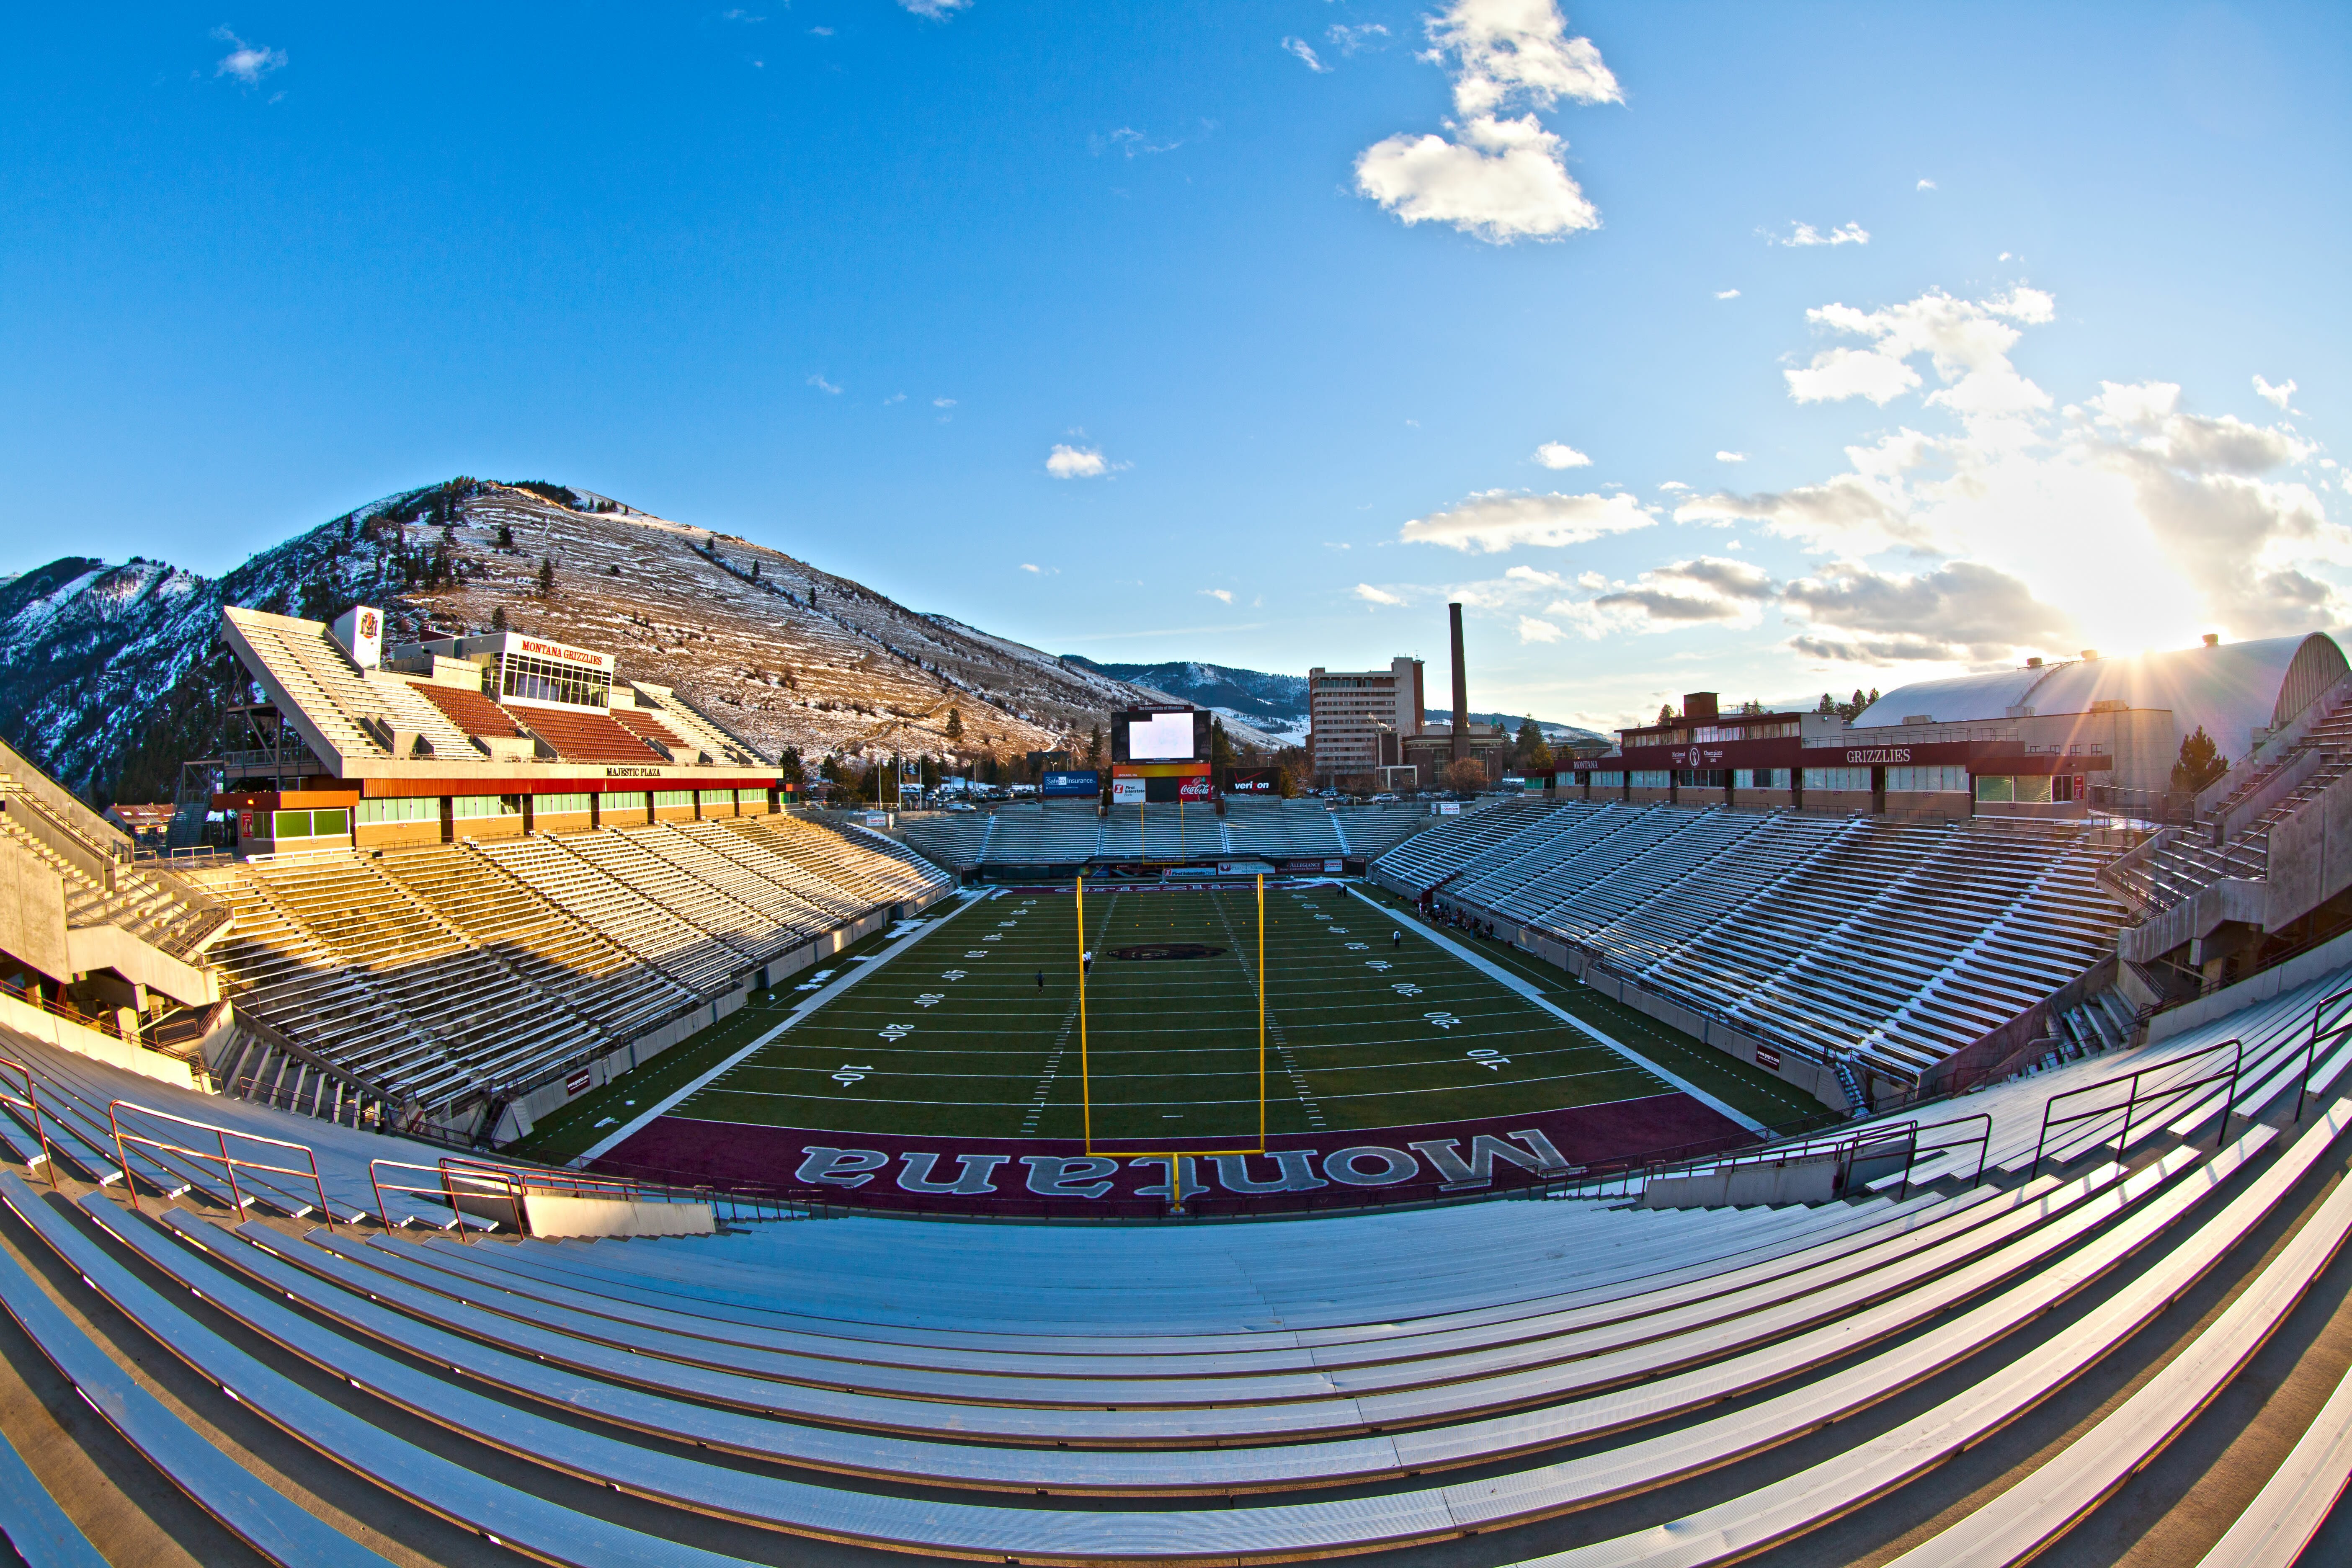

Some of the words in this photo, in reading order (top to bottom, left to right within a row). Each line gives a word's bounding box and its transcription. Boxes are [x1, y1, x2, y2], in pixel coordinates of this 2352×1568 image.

[522, 640, 562, 658] MONTANA
[564, 650, 602, 665] GRIZZLIES
[1847, 749, 1910, 763] GRIZZLIES
[1573, 761, 1598, 769] MONTANA
[606, 768, 639, 776] MAJESTIC
[1235, 781, 1269, 790] verizon
[941, 970, 968, 979] 40
[1391, 984, 1423, 994] 30
[914, 993, 944, 1004] 30
[1424, 1012, 1462, 1026] 20
[879, 1024, 915, 1037] 20
[1467, 1050, 1511, 1066] 10
[832, 1064, 874, 1081] 10
[794, 1130, 1587, 1199] Montana
